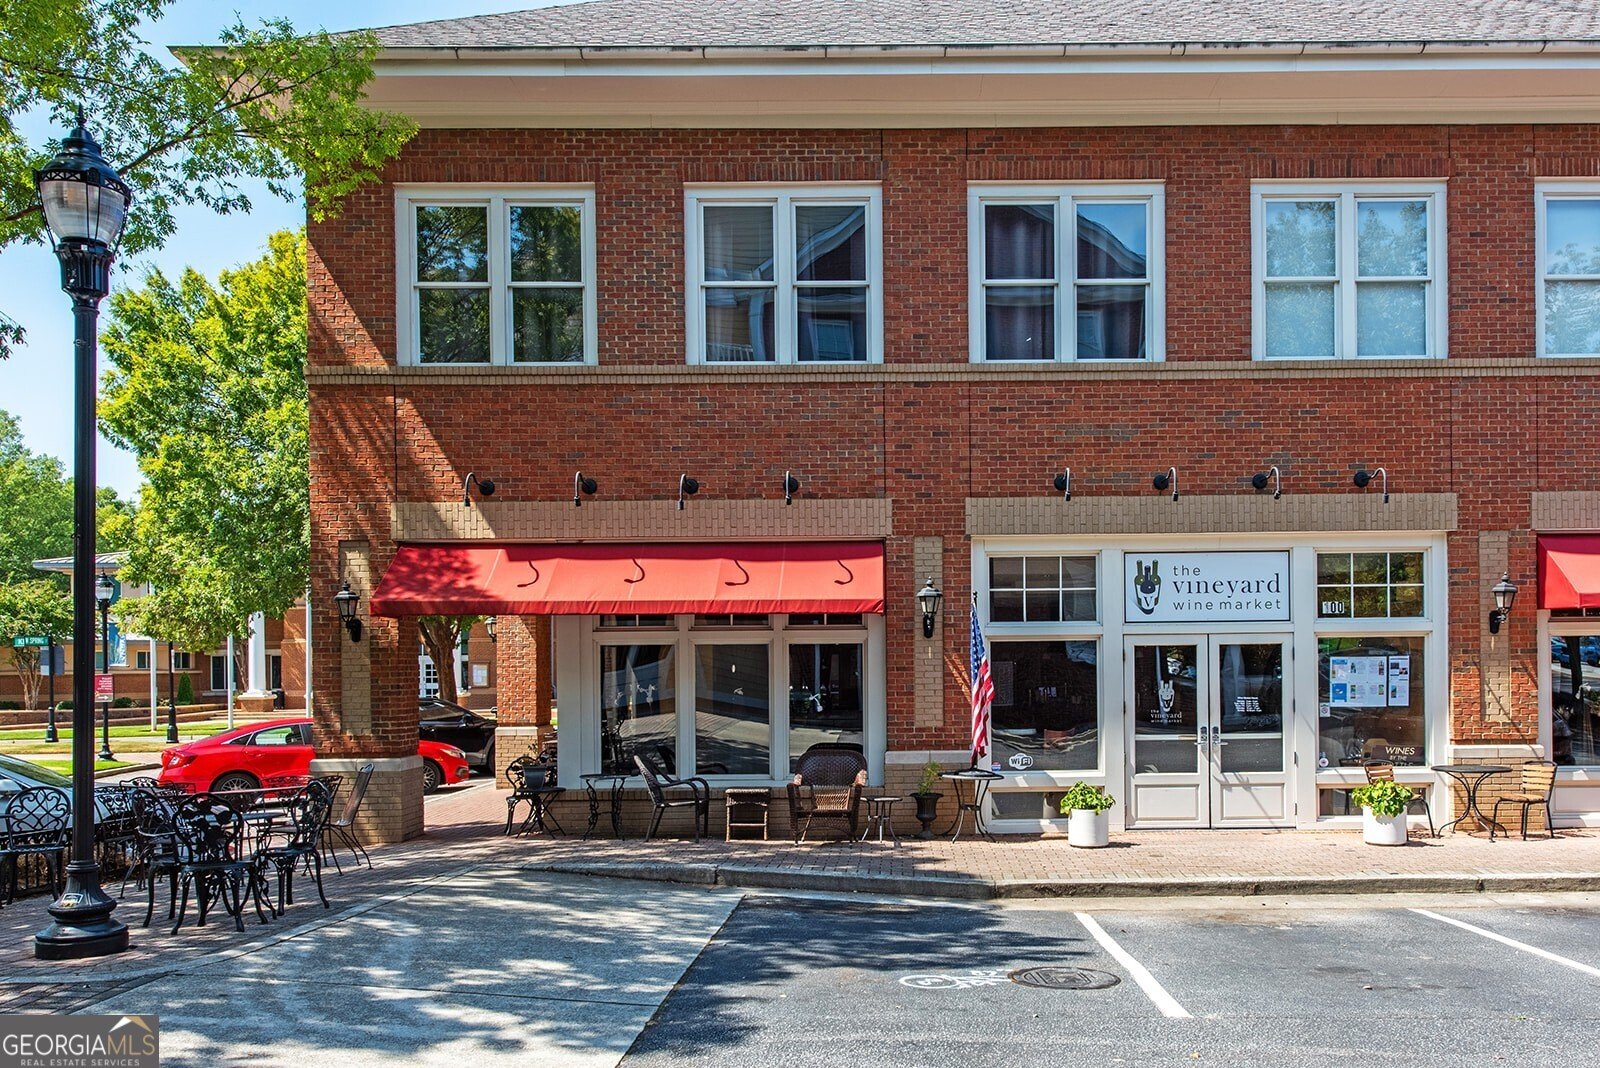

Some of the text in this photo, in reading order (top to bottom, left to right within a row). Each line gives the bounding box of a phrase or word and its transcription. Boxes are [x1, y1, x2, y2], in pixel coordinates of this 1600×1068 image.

[1173, 565, 1201, 576] the
[1172, 573, 1281, 598] vineyard
[1173, 598, 1281, 610] wine market
[1150, 711, 1182, 719] vineyard
[1385, 746, 1415, 755] WINES
